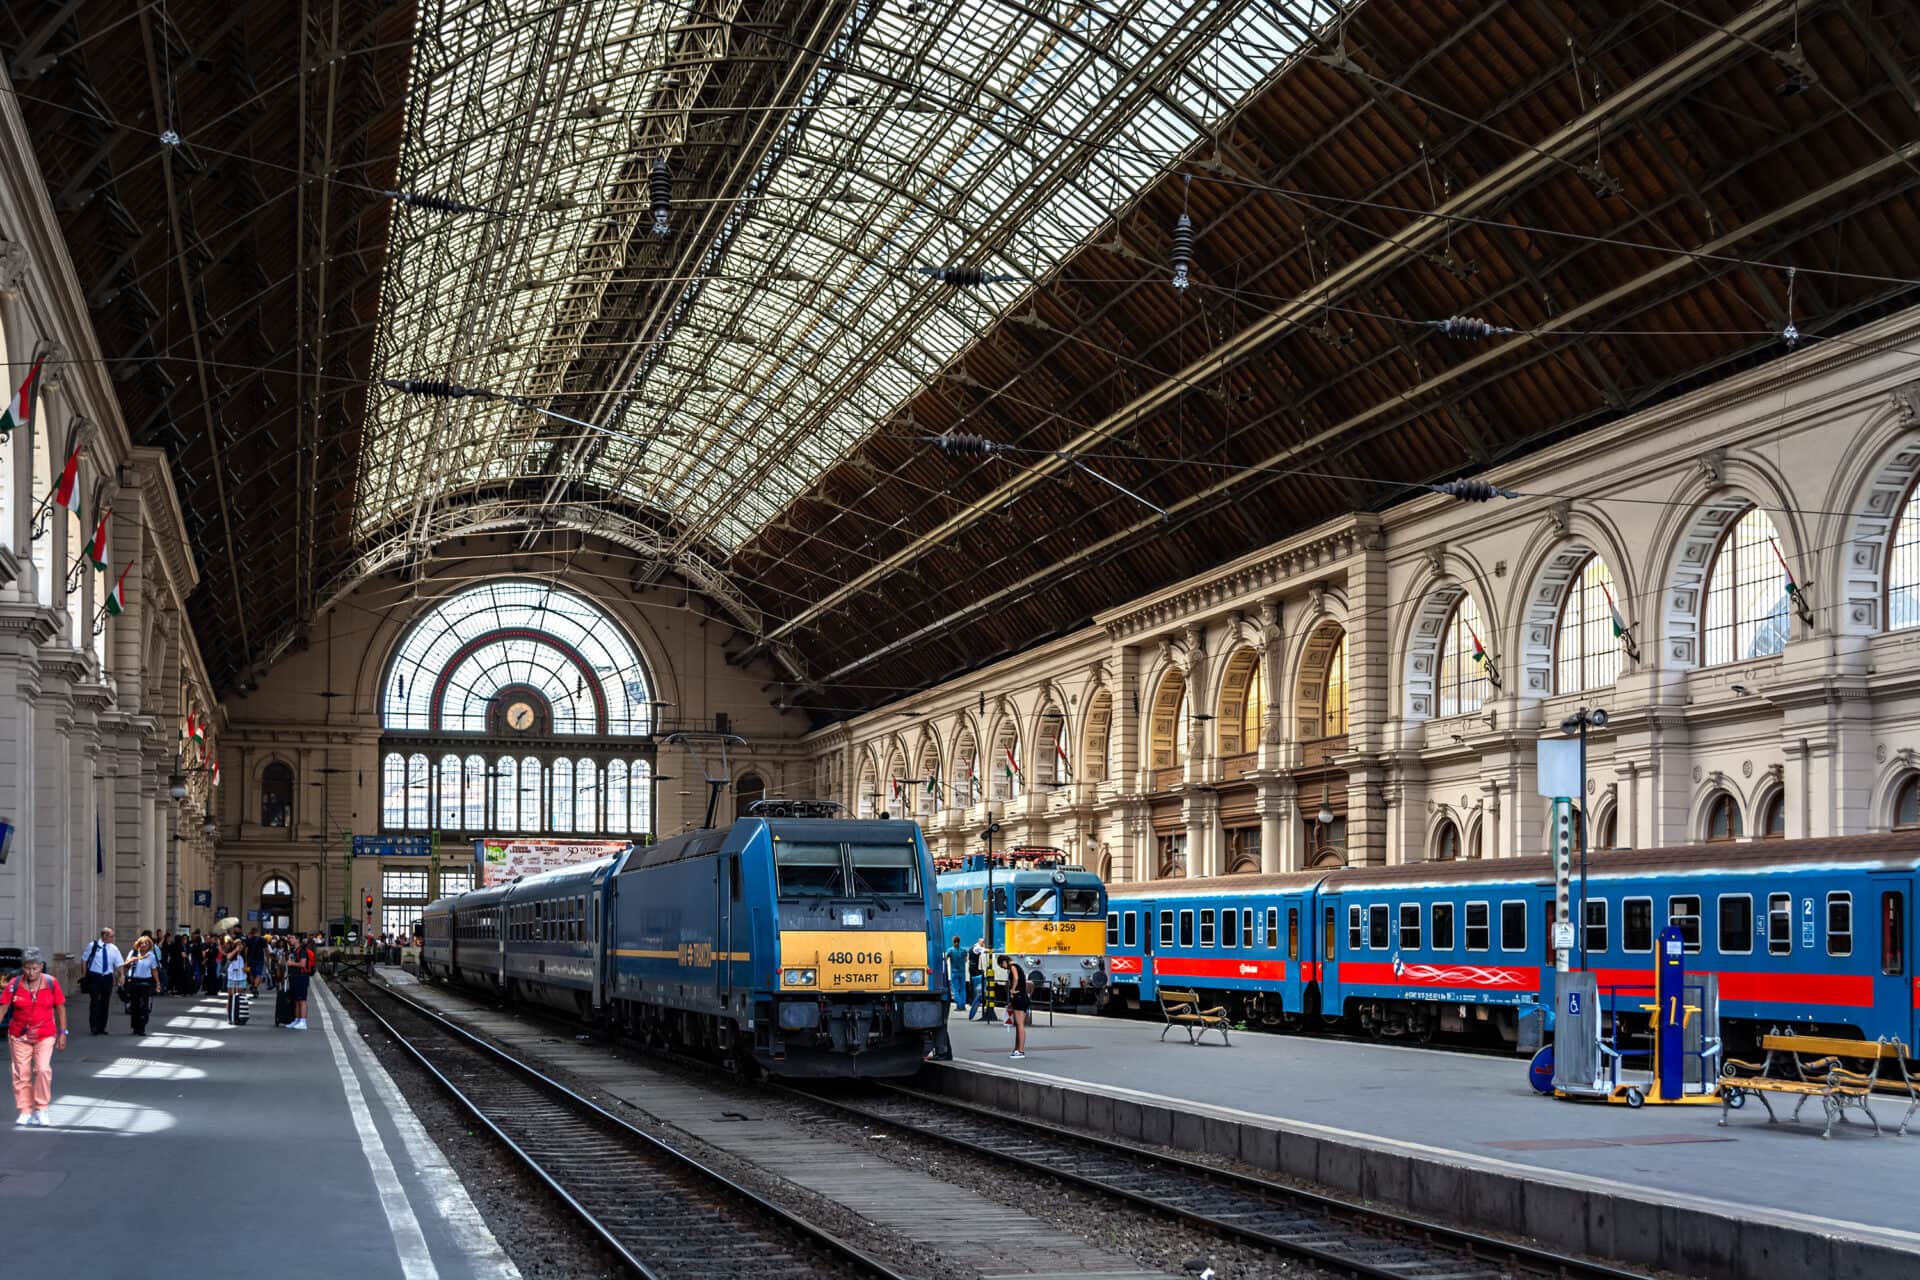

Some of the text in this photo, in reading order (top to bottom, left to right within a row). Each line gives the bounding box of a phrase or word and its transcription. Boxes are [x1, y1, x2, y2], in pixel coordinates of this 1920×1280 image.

[1804, 900, 1812, 915] 2
[1043, 923, 1076, 933] 431 259
[827, 952, 882, 964] 480 016
[833, 973, 879, 985] H-START
